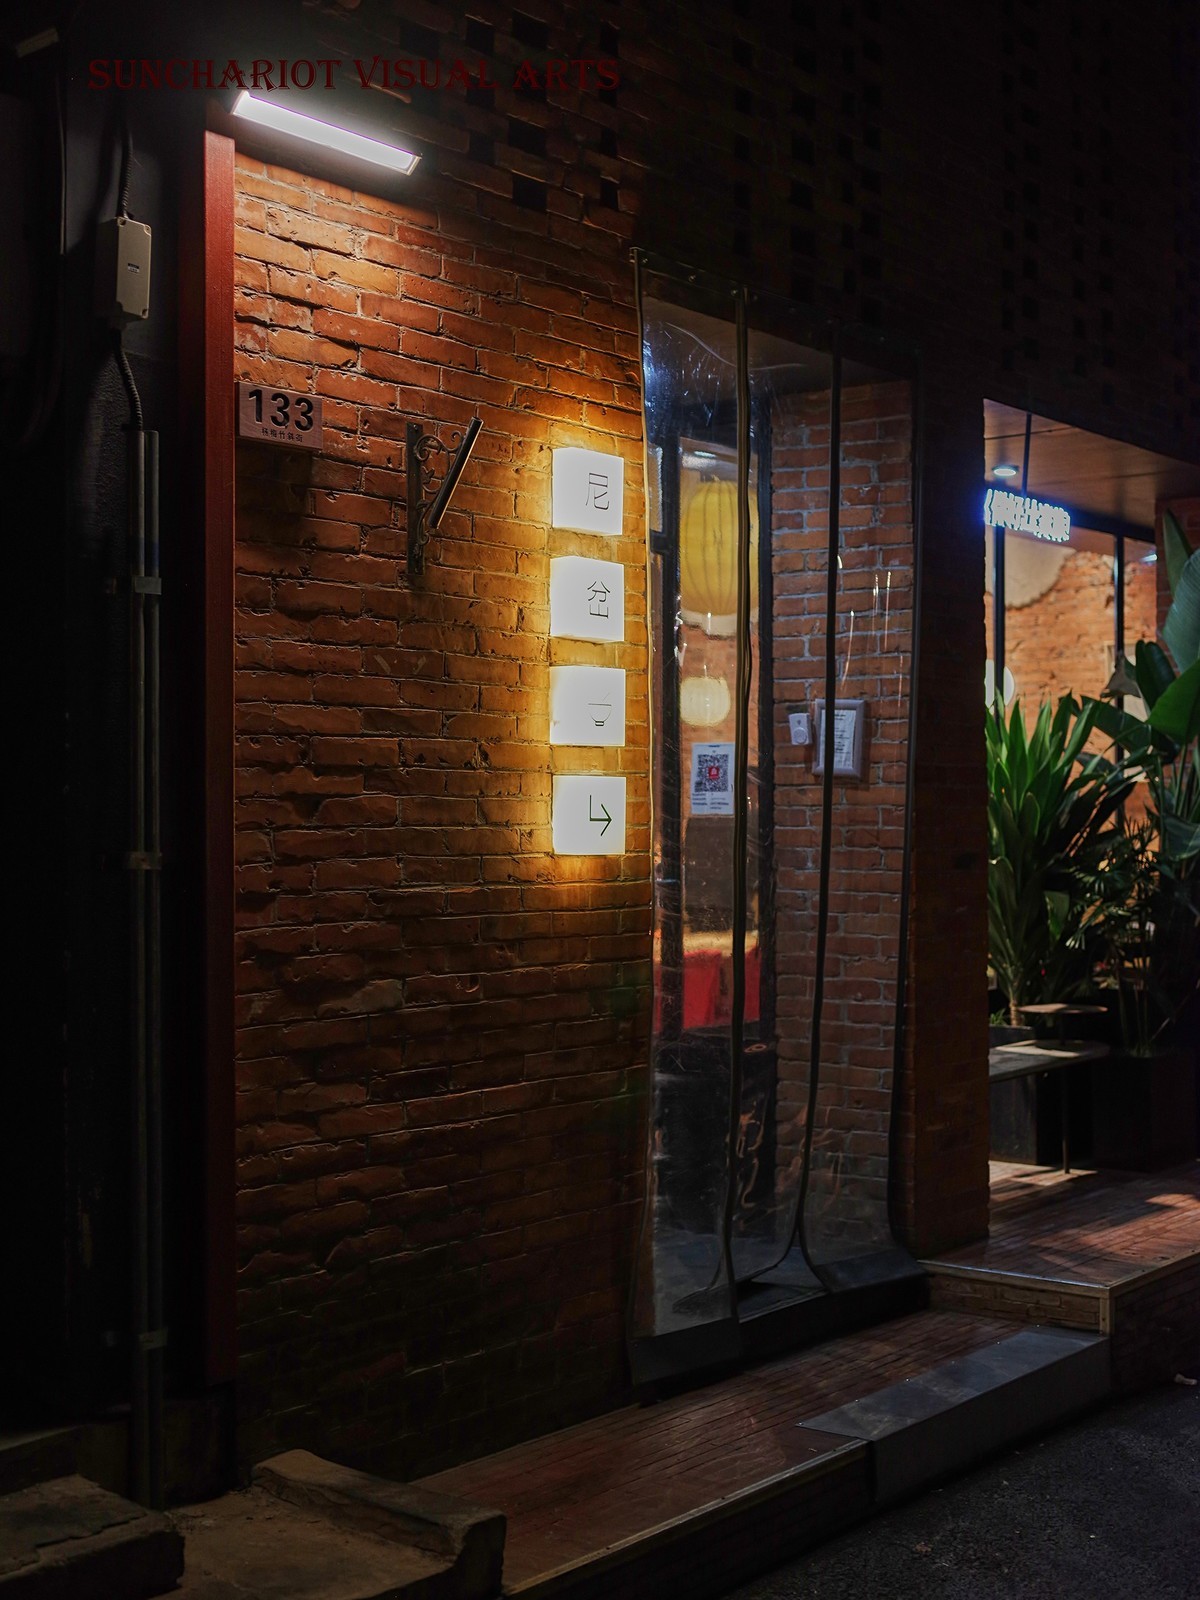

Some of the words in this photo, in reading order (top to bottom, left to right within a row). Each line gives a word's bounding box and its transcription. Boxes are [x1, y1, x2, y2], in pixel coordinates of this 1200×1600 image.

[248, 389, 314, 432] 133
[585, 472, 610, 510] 尼
[587, 580, 611, 619] 岔
